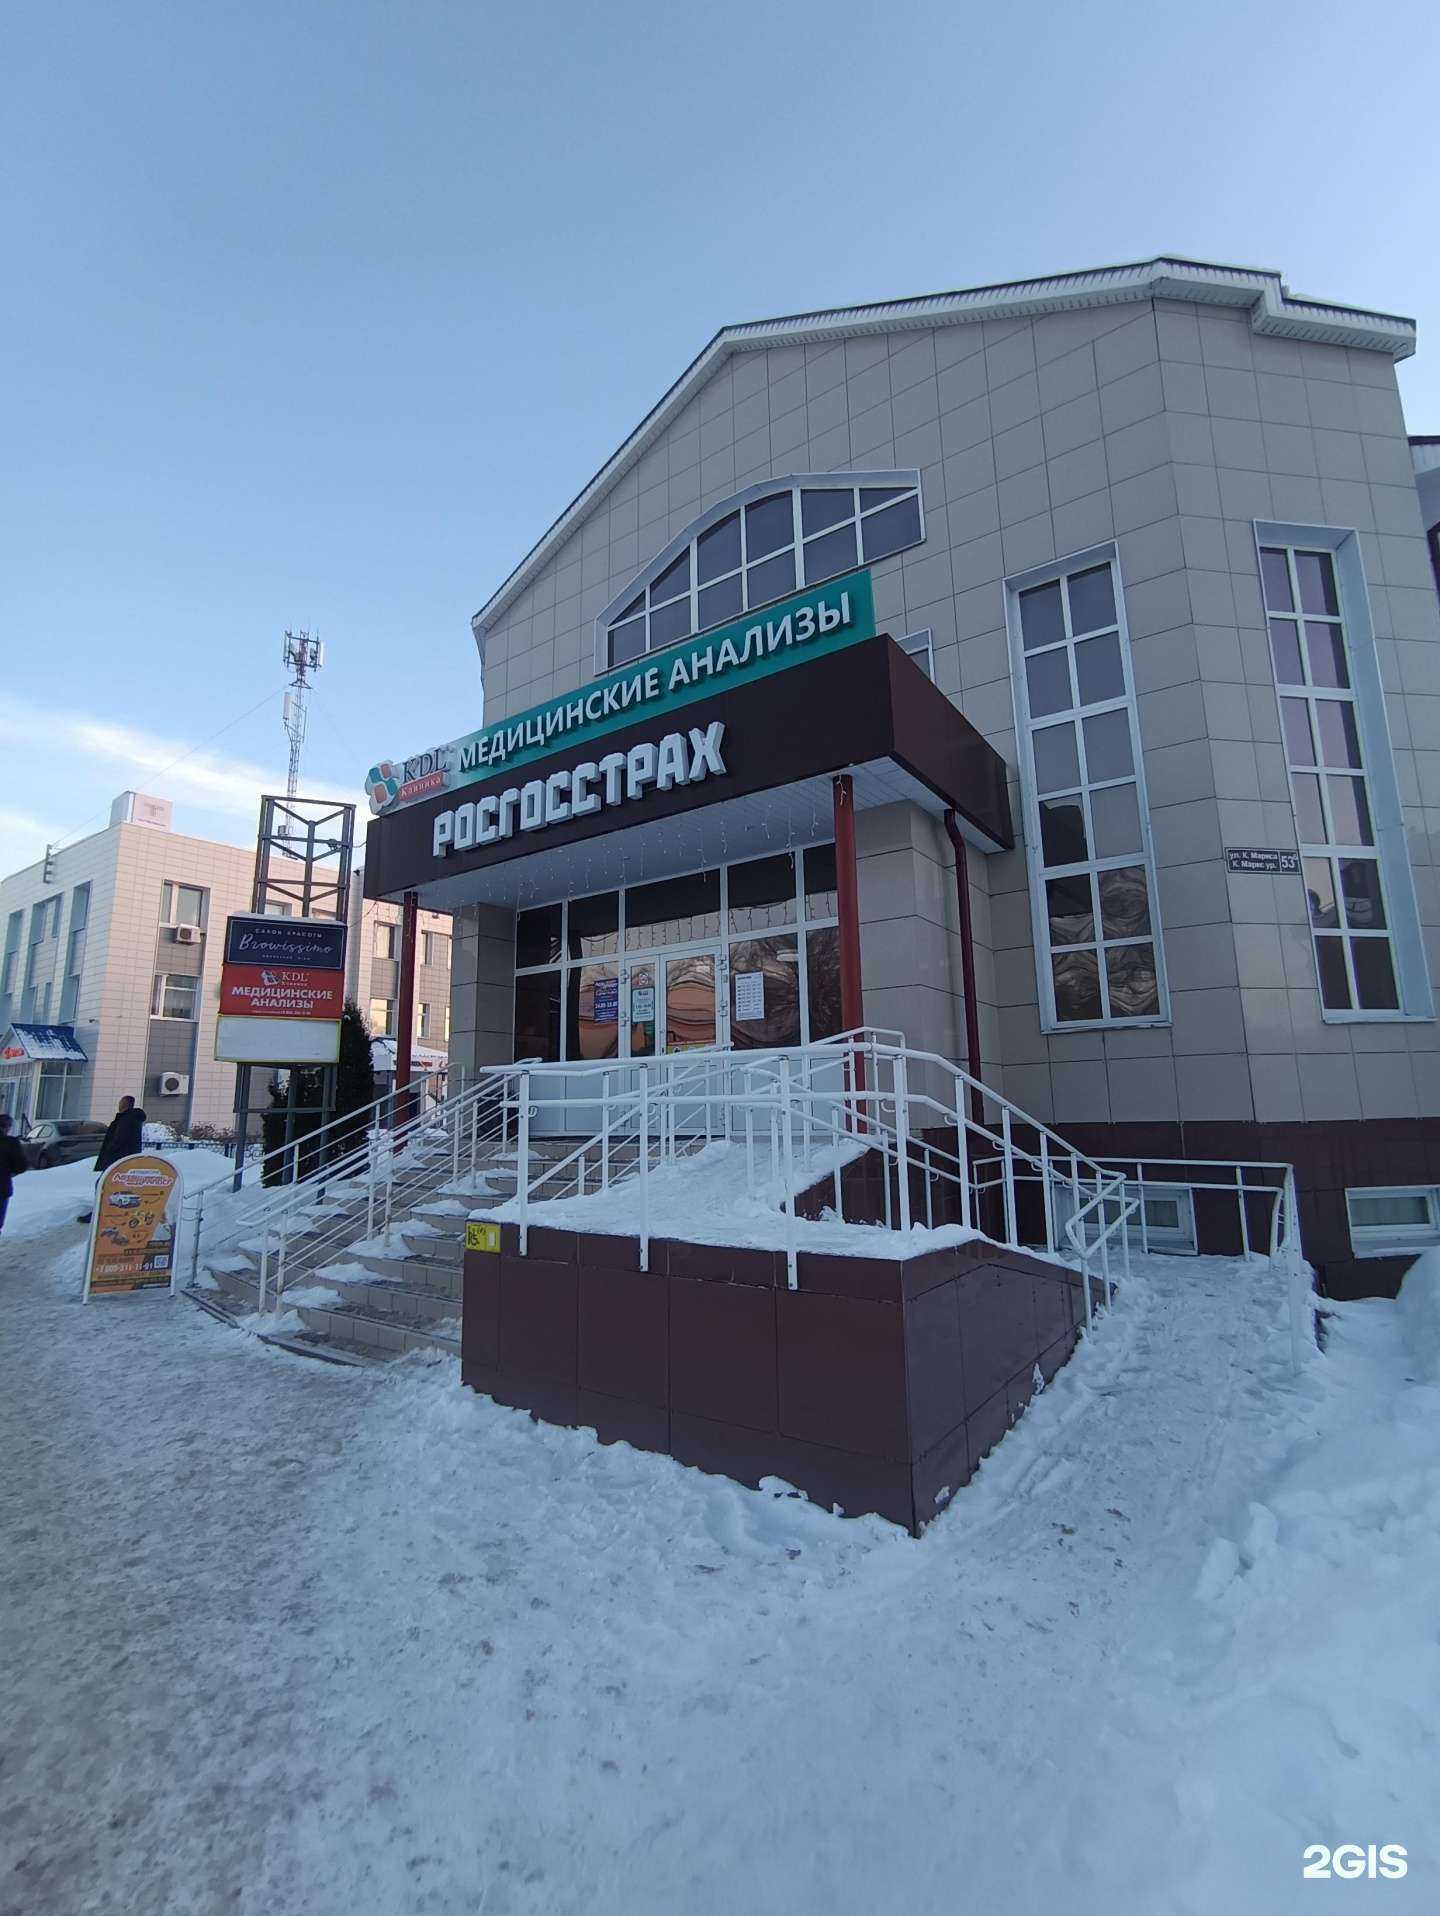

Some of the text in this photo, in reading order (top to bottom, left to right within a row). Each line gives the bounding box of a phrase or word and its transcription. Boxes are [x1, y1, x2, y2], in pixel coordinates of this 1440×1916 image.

[456, 592, 851, 772] МЕДИЦИНСКИЕ АНАЛИЗЫ
[402, 745, 450, 784] KDL
[401, 776, 442, 797] Клиника
[432, 721, 728, 858] РОСГОССТРАХ
[281, 971, 308, 981] KDL
[231, 986, 333, 1000] МЕДИЦИНСКИЕ
[250, 998, 314, 1009] АНАЛИЗЫ
